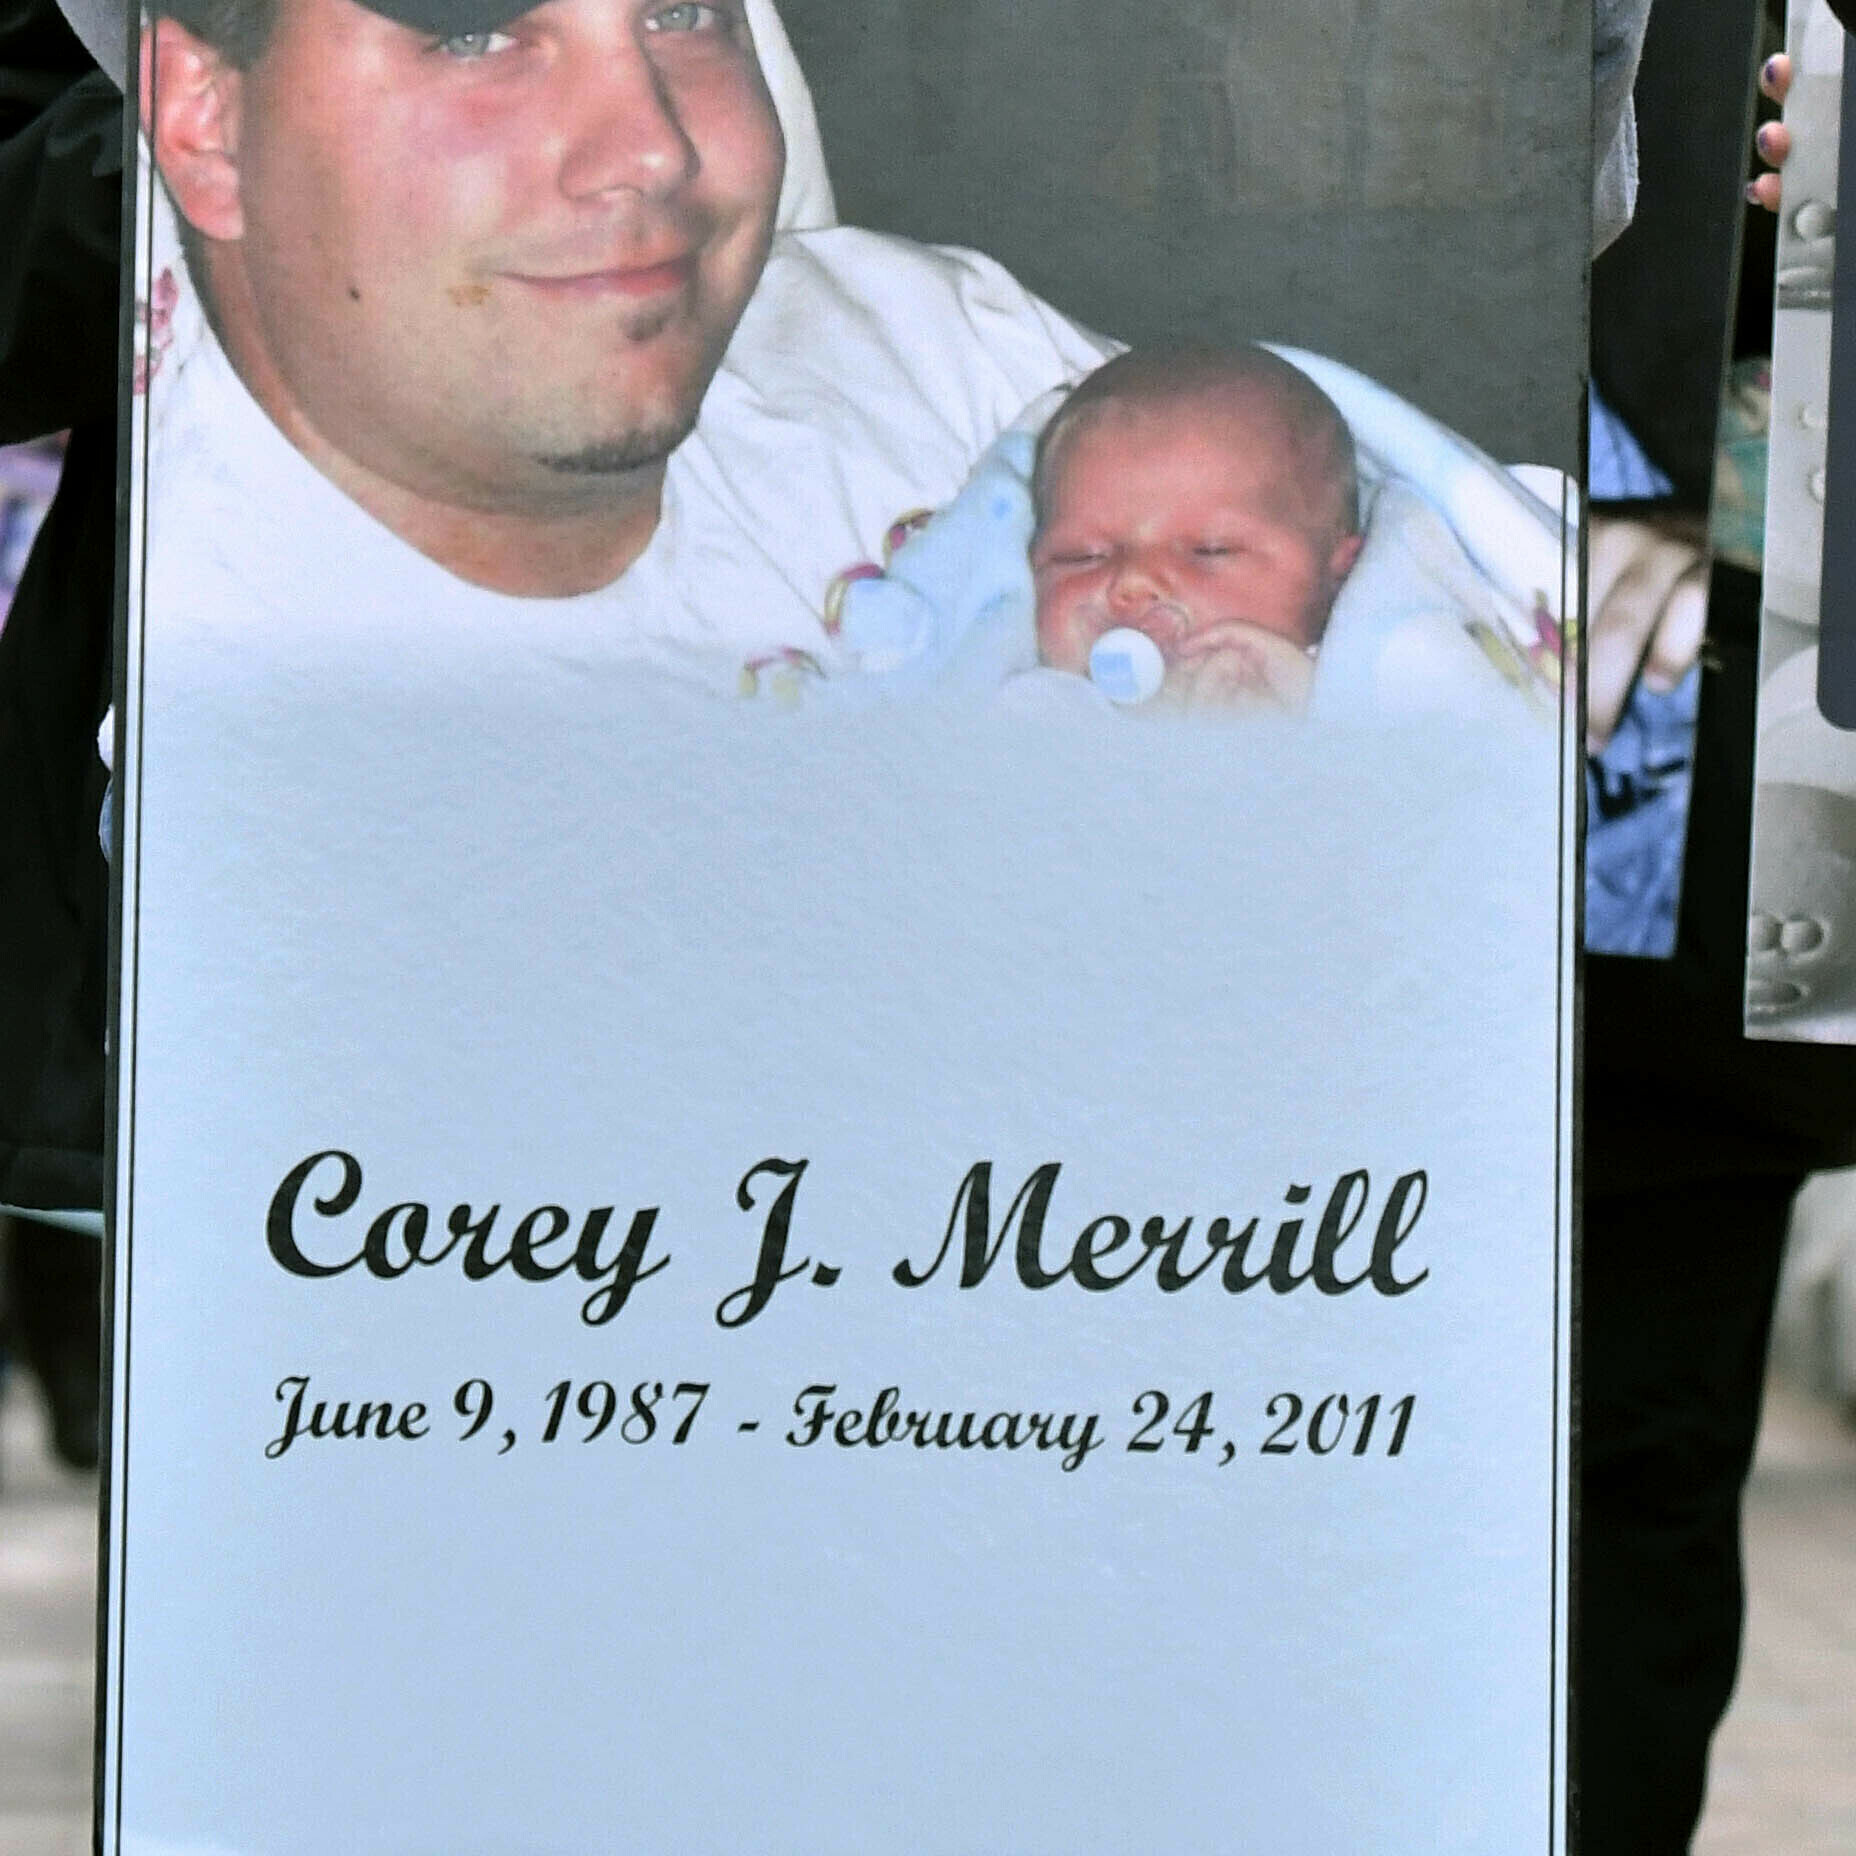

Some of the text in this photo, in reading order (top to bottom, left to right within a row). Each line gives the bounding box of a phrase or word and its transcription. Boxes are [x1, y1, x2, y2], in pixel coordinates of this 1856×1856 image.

[266, 1150, 1429, 1329] Corey J. Merrill
[265, 1376, 430, 1459] June
[454, 1379, 516, 1455] 9,
[542, 1380, 711, 1445] 1987
[785, 1384, 1105, 1473] February
[1126, 1390, 1236, 1467] 24,
[1260, 1392, 1416, 1457] 2011
